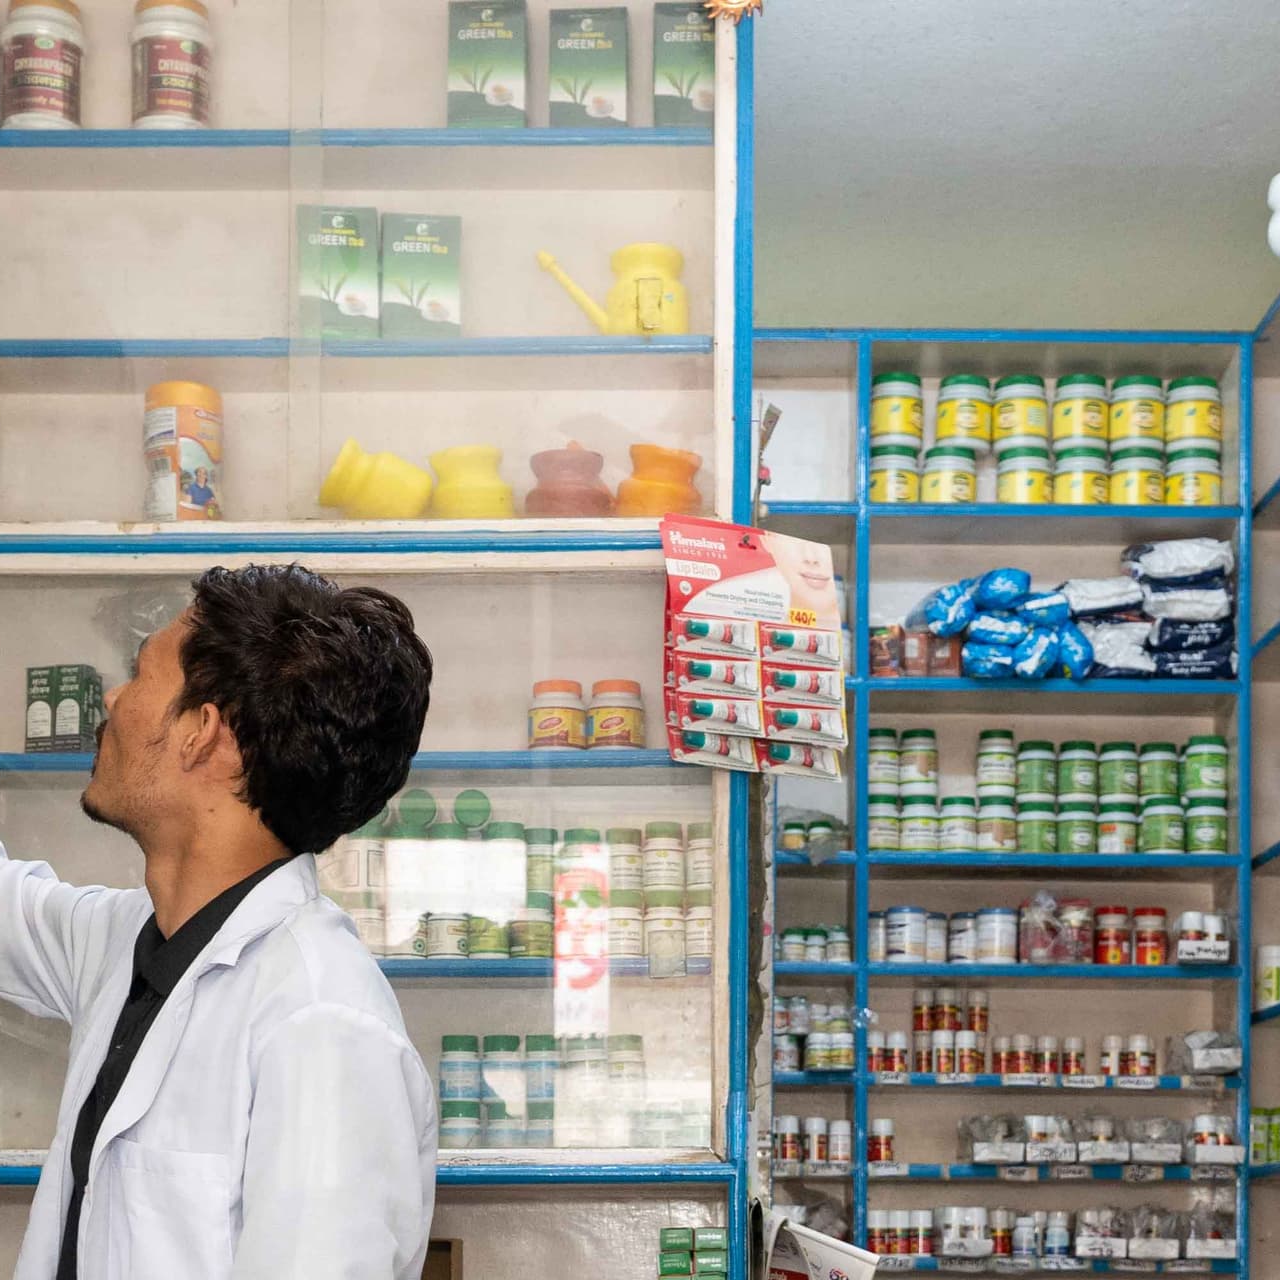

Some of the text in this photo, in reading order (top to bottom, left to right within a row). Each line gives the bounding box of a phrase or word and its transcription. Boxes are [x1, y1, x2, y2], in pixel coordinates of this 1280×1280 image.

[458, 29, 496, 40] GREEN
[663, 31, 701, 42] GREEN
[558, 39, 596, 50] GREEN
[309, 235, 347, 246] GREEN
[393, 241, 431, 254] GREEN
[669, 530, 726, 552] Himalaya
[676, 562, 718, 579] Lip Balm
